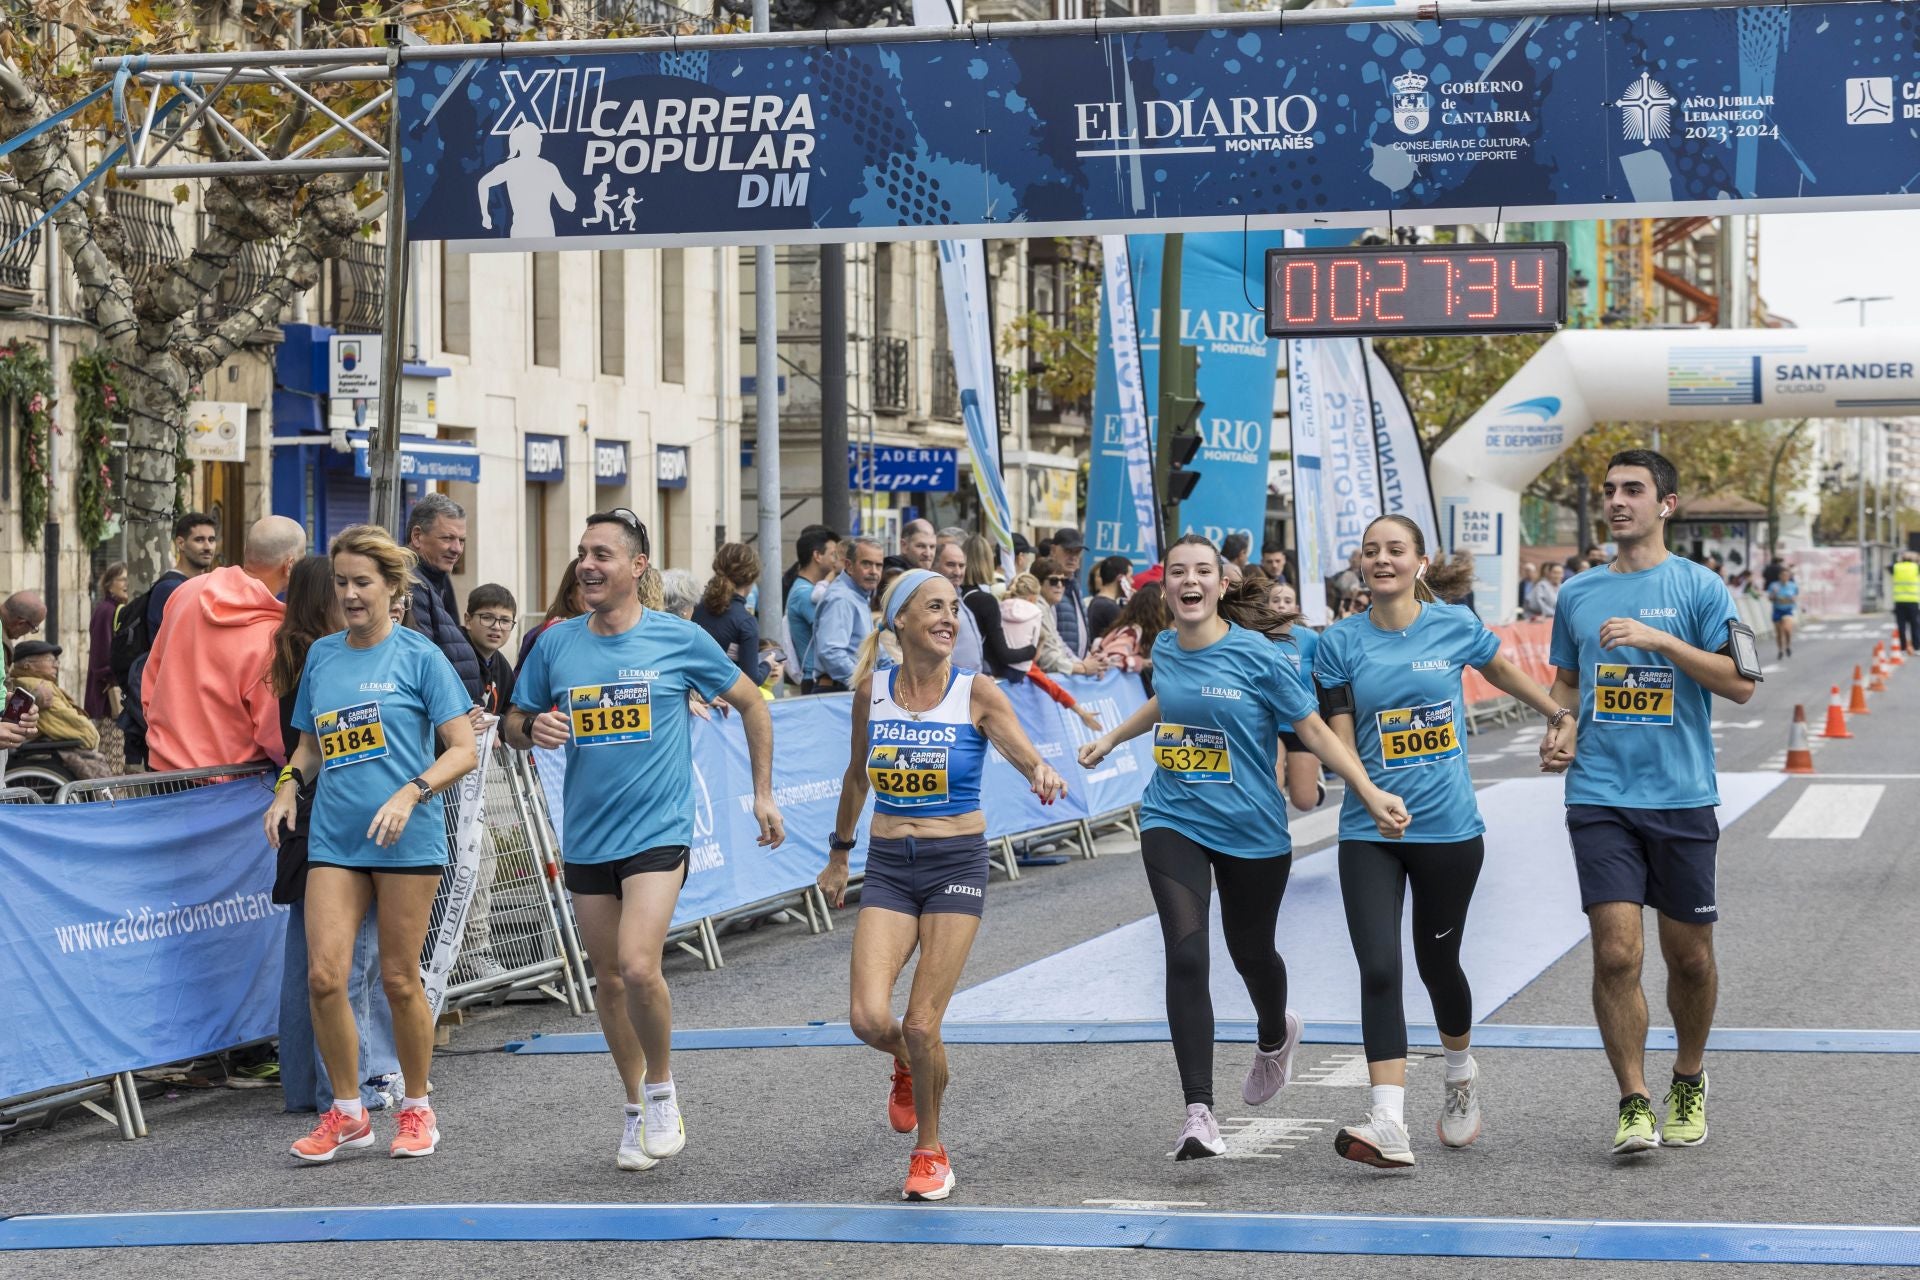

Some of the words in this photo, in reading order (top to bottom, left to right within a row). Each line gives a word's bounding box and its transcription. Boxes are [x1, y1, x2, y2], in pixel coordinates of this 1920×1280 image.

[1441, 80, 1523, 95] GOBIERNO
[490, 66, 606, 136] XII
[1441, 98, 1456, 110] de
[1684, 94, 1715, 108] AÑO
[1718, 94, 1775, 108] JUBILAR
[591, 93, 816, 138] CARRERA
[1074, 102, 1137, 142] EL
[1144, 94, 1318, 139] DIARIO
[1441, 109, 1531, 125] CANTABRIA
[1684, 109, 1763, 122] LEBANIEGO
[1225, 133, 1314, 153] MONTAÑÉS
[1393, 136, 1461, 151] CONSEJERÍA
[1462, 138, 1477, 149] DE
[1478, 136, 1531, 149] CULTURA,
[582, 132, 815, 175] POPULAR
[1407, 152, 1455, 164] TURISMO
[1457, 151, 1465, 162] Y
[1467, 149, 1517, 162] DEPORTE
[737, 172, 810, 208] DM
[1286, 256, 1543, 323] 00:27:34
[1775, 362, 1914, 382] SANTANDER
[1775, 383, 1826, 394] CIUDAD
[1486, 434, 1501, 447] DE
[1504, 433, 1564, 447] DEPORTES
[527, 439, 563, 473] BBVA
[598, 445, 627, 477] BBVA
[659, 450, 688, 480] BBVA
[854, 464, 944, 490] Capri
[1462, 511, 1490, 521] SAN
[1463, 522, 1490, 531] TAN
[1095, 521, 1131, 552] EL
[1462, 533, 1489, 542] DER
[1640, 608, 1649, 616] EL
[1650, 607, 1678, 617] DIARIO
[1412, 661, 1423, 669] EL
[1424, 660, 1451, 669] DIARIO
[618, 669, 629, 677] EL
[630, 669, 659, 678] DIARIO
[1604, 671, 1616, 679] 5K
[369, 682, 396, 690] DIARIO
[614, 687, 647, 695] CARRERA
[1201, 686, 1212, 695] EL
[1212, 687, 1242, 698] DIARIO
[579, 694, 591, 702] 5K
[1604, 690, 1663, 711] 5067
[348, 707, 377, 718] CARRERA
[348, 713, 378, 723] POPULAR
[1425, 711, 1452, 722] POPULAR
[320, 720, 330, 729] 5K
[581, 708, 641, 733] 5183
[1389, 716, 1401, 725] 5K
[873, 722, 956, 746] PiélagoS
[1162, 732, 1174, 740] 5K
[1195, 733, 1224, 741] CARRERA
[1392, 728, 1451, 755] 5066
[324, 727, 376, 757] 5184
[877, 753, 888, 761] 5K
[1161, 748, 1223, 771] 5327
[877, 772, 938, 793] 5286
[464, 870, 477, 900] MONTAÑÉS
[447, 865, 472, 926] DIARIO
[1694, 905, 1716, 913] adida
[55, 891, 290, 953] www.eldiariomontan
